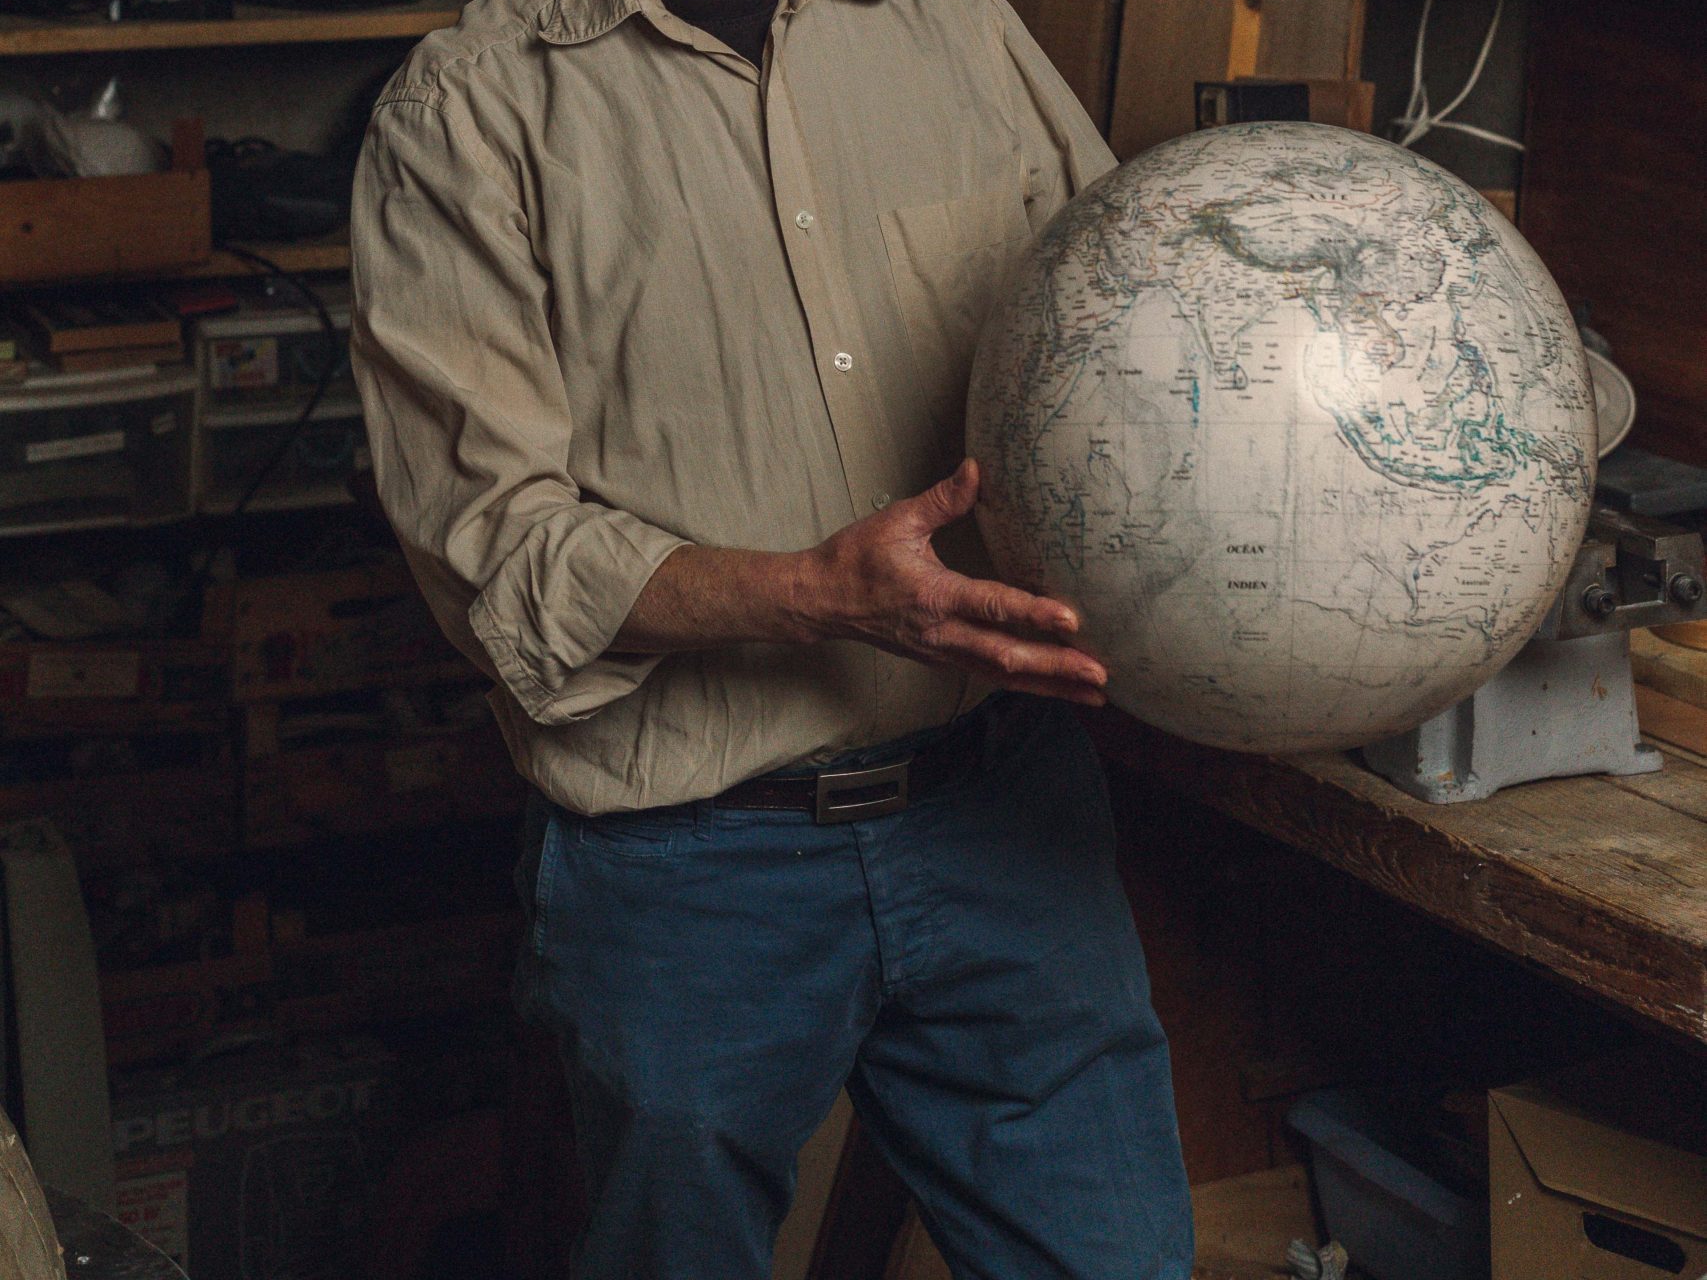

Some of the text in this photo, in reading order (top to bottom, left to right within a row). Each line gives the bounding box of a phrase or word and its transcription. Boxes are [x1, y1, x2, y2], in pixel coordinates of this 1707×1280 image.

[1226, 542, 1267, 554] OCÉAN
[1227, 579, 1268, 590] INDIEN
[114, 1077, 378, 1151] PEUGEOT
